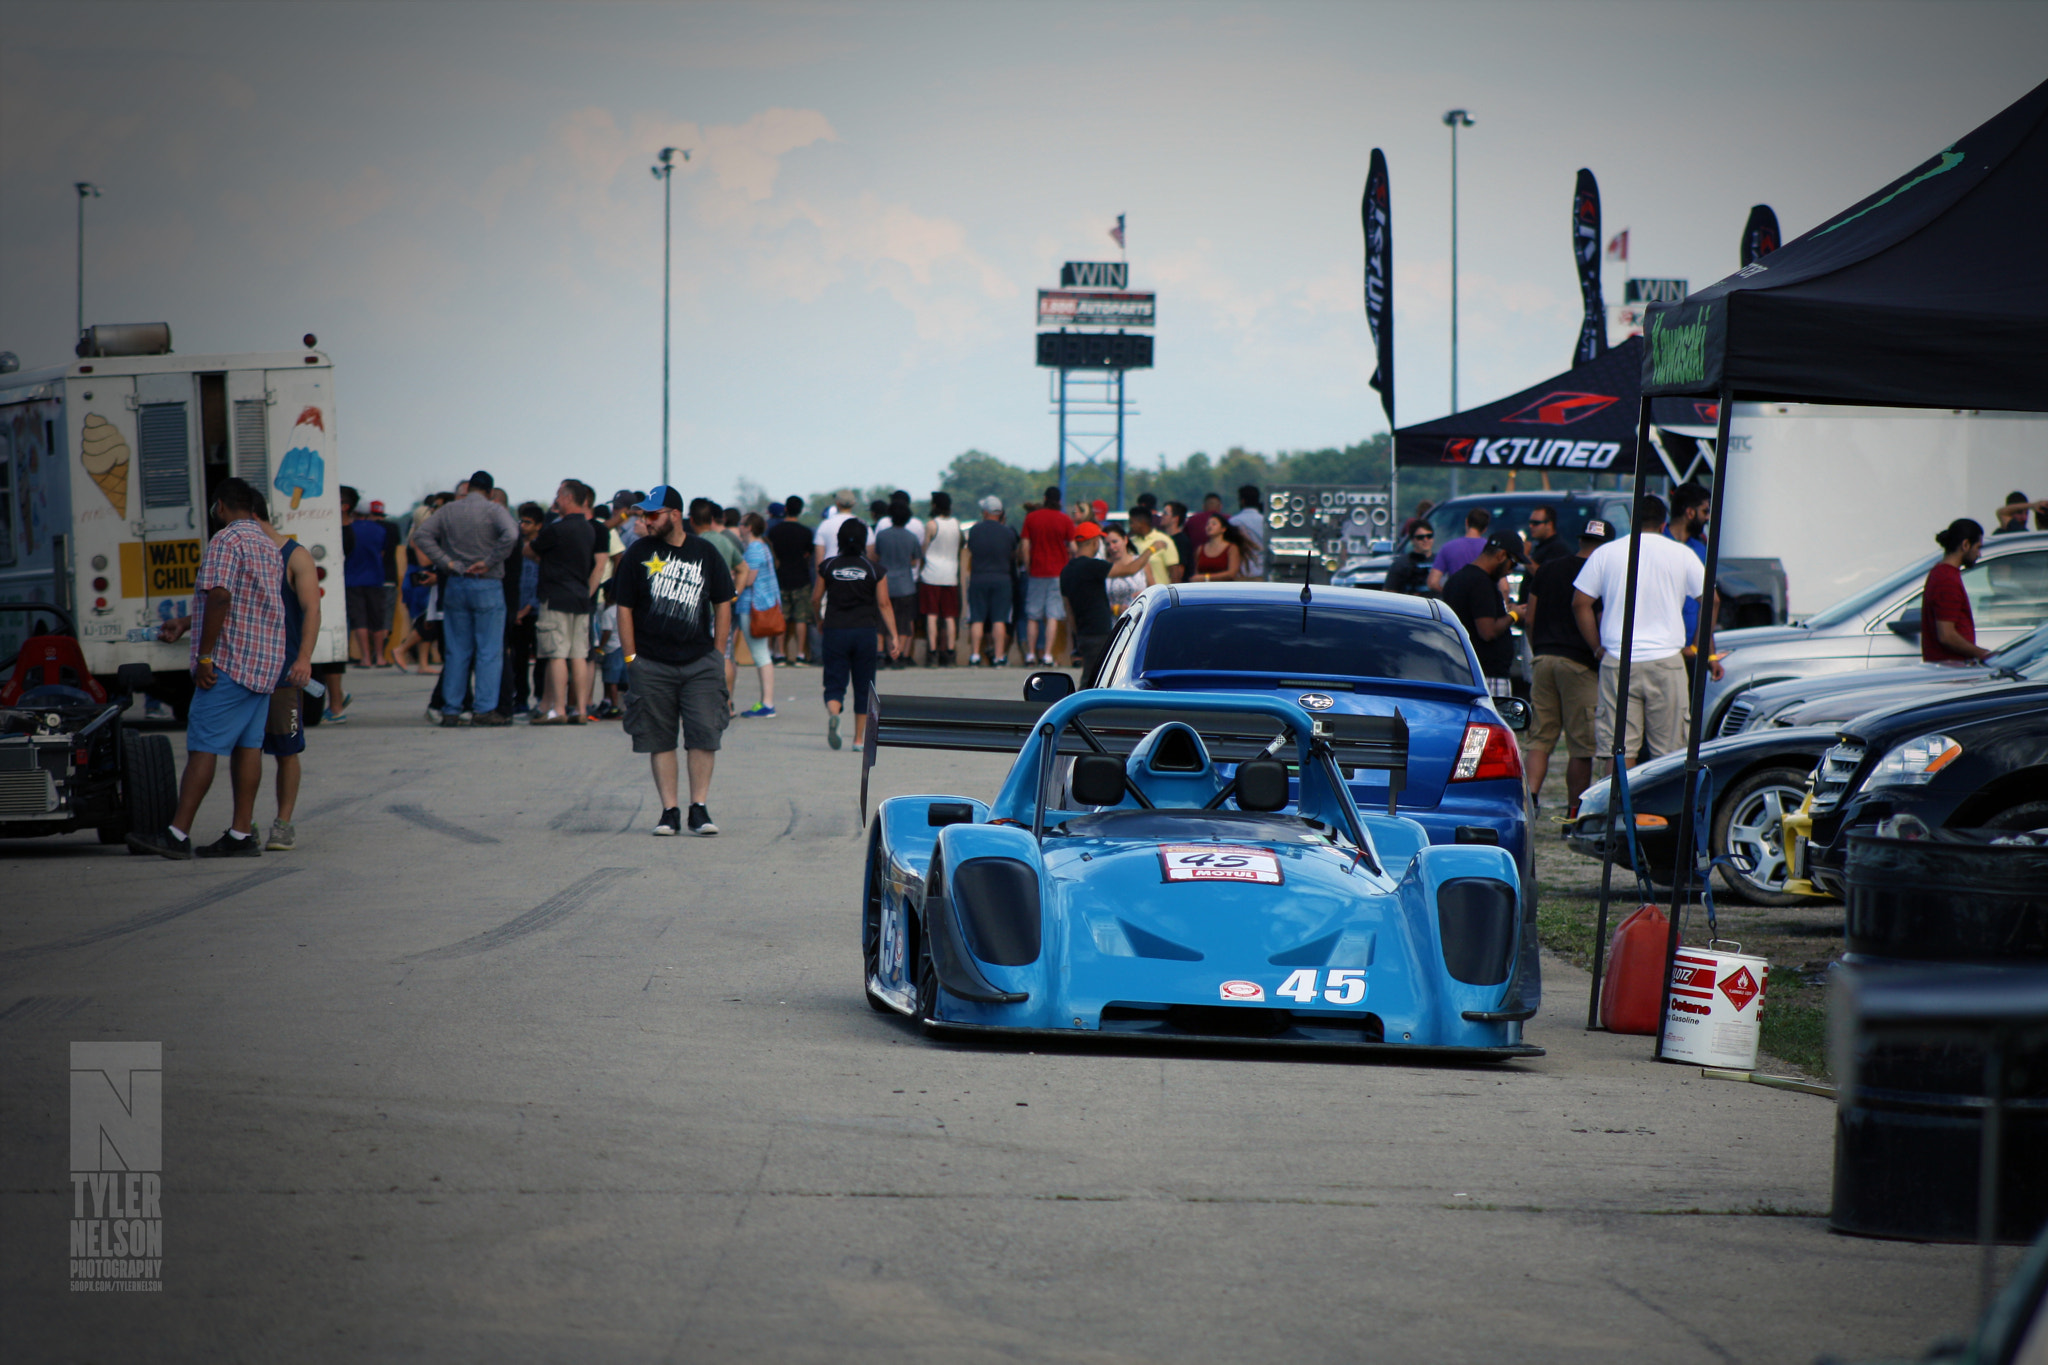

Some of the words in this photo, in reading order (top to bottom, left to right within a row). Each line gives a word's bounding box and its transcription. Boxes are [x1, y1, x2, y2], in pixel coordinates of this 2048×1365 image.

[1072, 263, 1126, 287] WIN
[1637, 280, 1686, 301] WIN
[1651, 305, 1711, 385] Kawasaki
[1469, 438, 1621, 468] K-TUNED
[149, 543, 200, 566] WATC
[154, 567, 200, 590] CHIL
[661, 552, 703, 584] METAL
[290, 708, 298, 738] RVCA
[1179, 852, 1253, 868] 45
[1195, 870, 1255, 878] MOTUL
[1276, 969, 1367, 1005] 45
[1671, 1014, 1700, 1025] Gasoline
